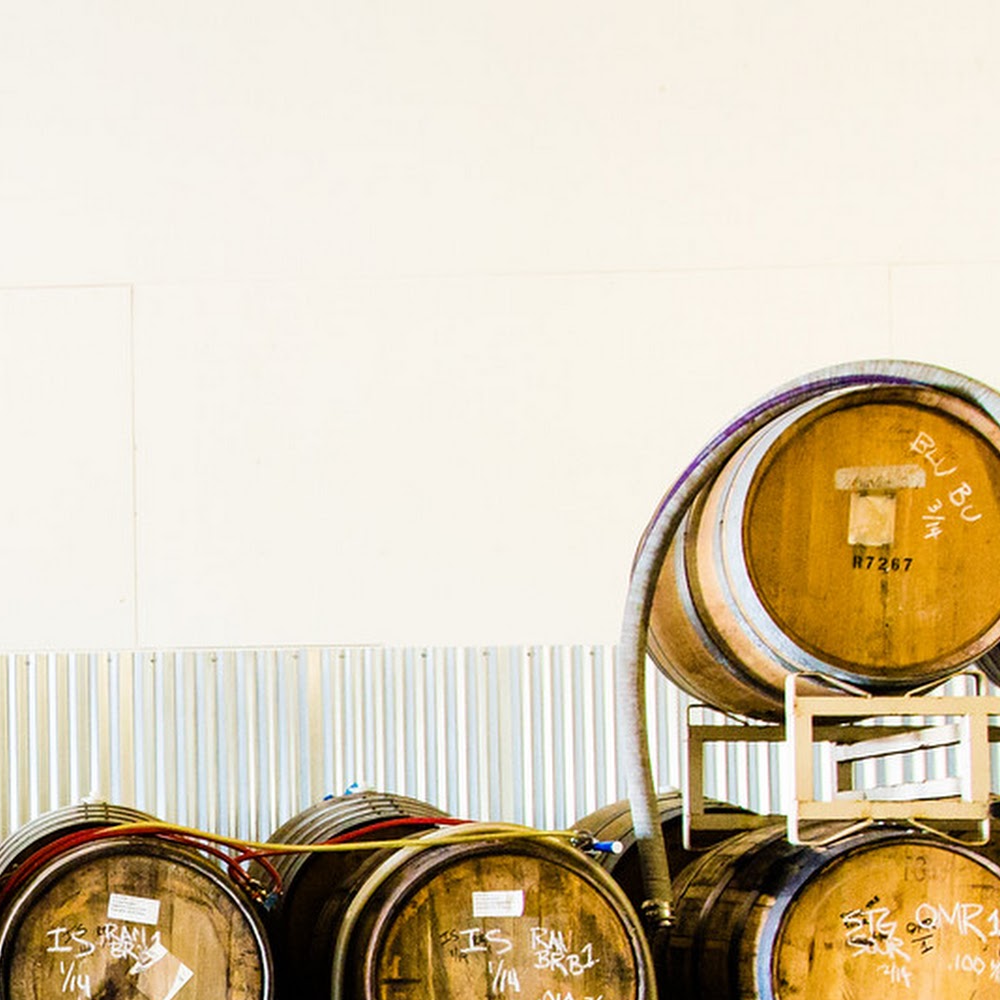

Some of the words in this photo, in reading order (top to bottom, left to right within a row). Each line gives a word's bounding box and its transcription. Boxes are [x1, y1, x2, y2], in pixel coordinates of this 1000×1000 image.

[948, 482, 983, 522] BU
[852, 555, 913, 574] R7267
[459, 926, 514, 955] IS
